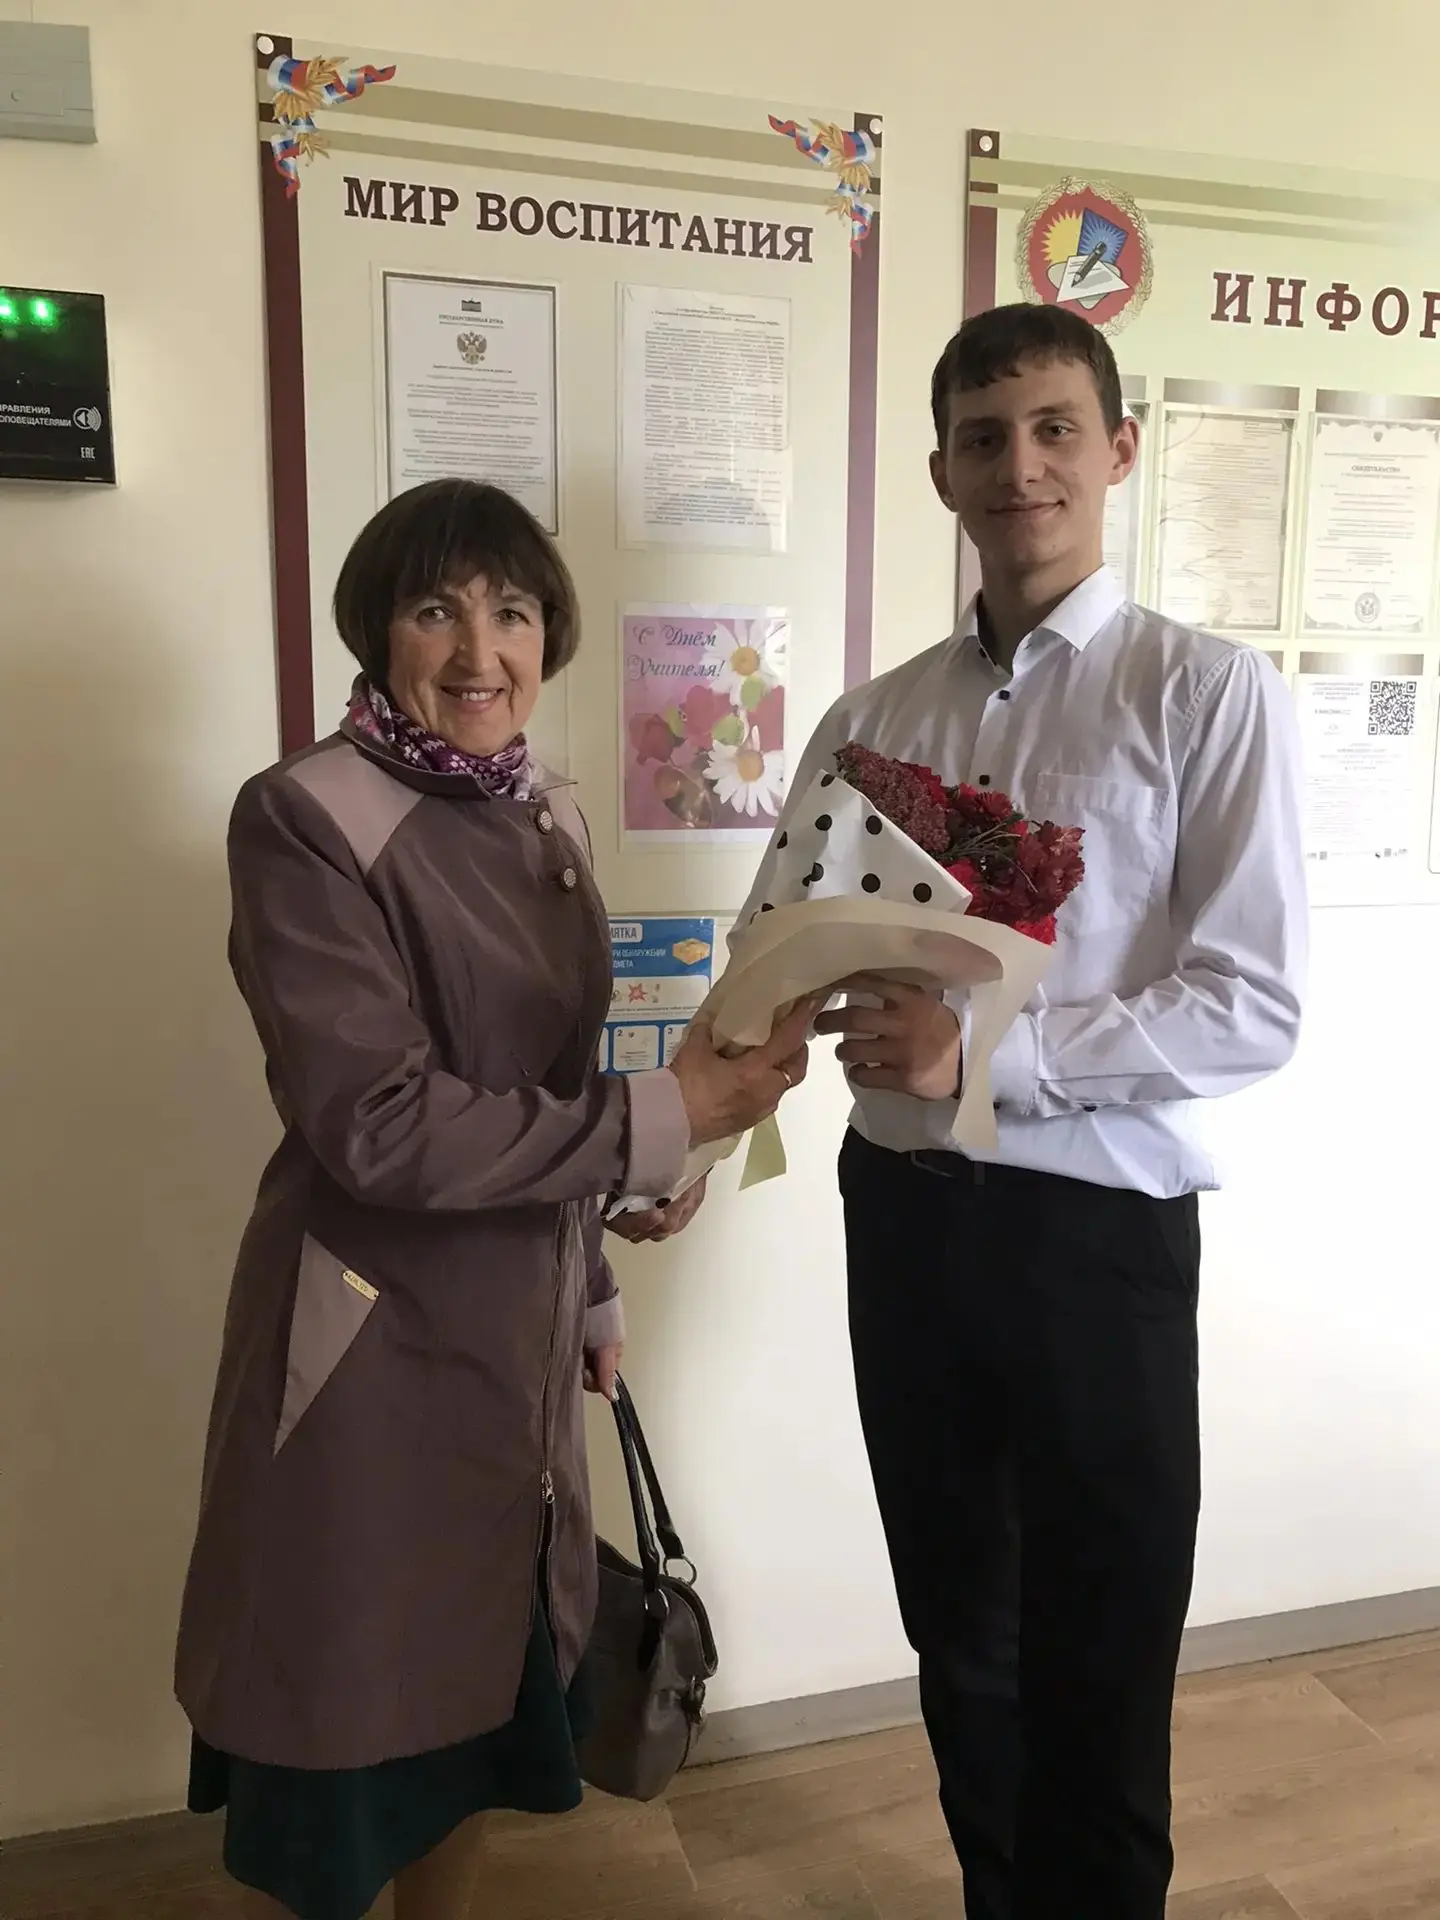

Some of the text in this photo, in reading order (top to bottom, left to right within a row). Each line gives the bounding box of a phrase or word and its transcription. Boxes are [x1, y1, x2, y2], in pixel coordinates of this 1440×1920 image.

[343, 176, 814, 263] МИР ВОСПИТАНИЯ
[632, 624, 717, 647] С Днём
[627, 654, 726, 682] Учителя!
